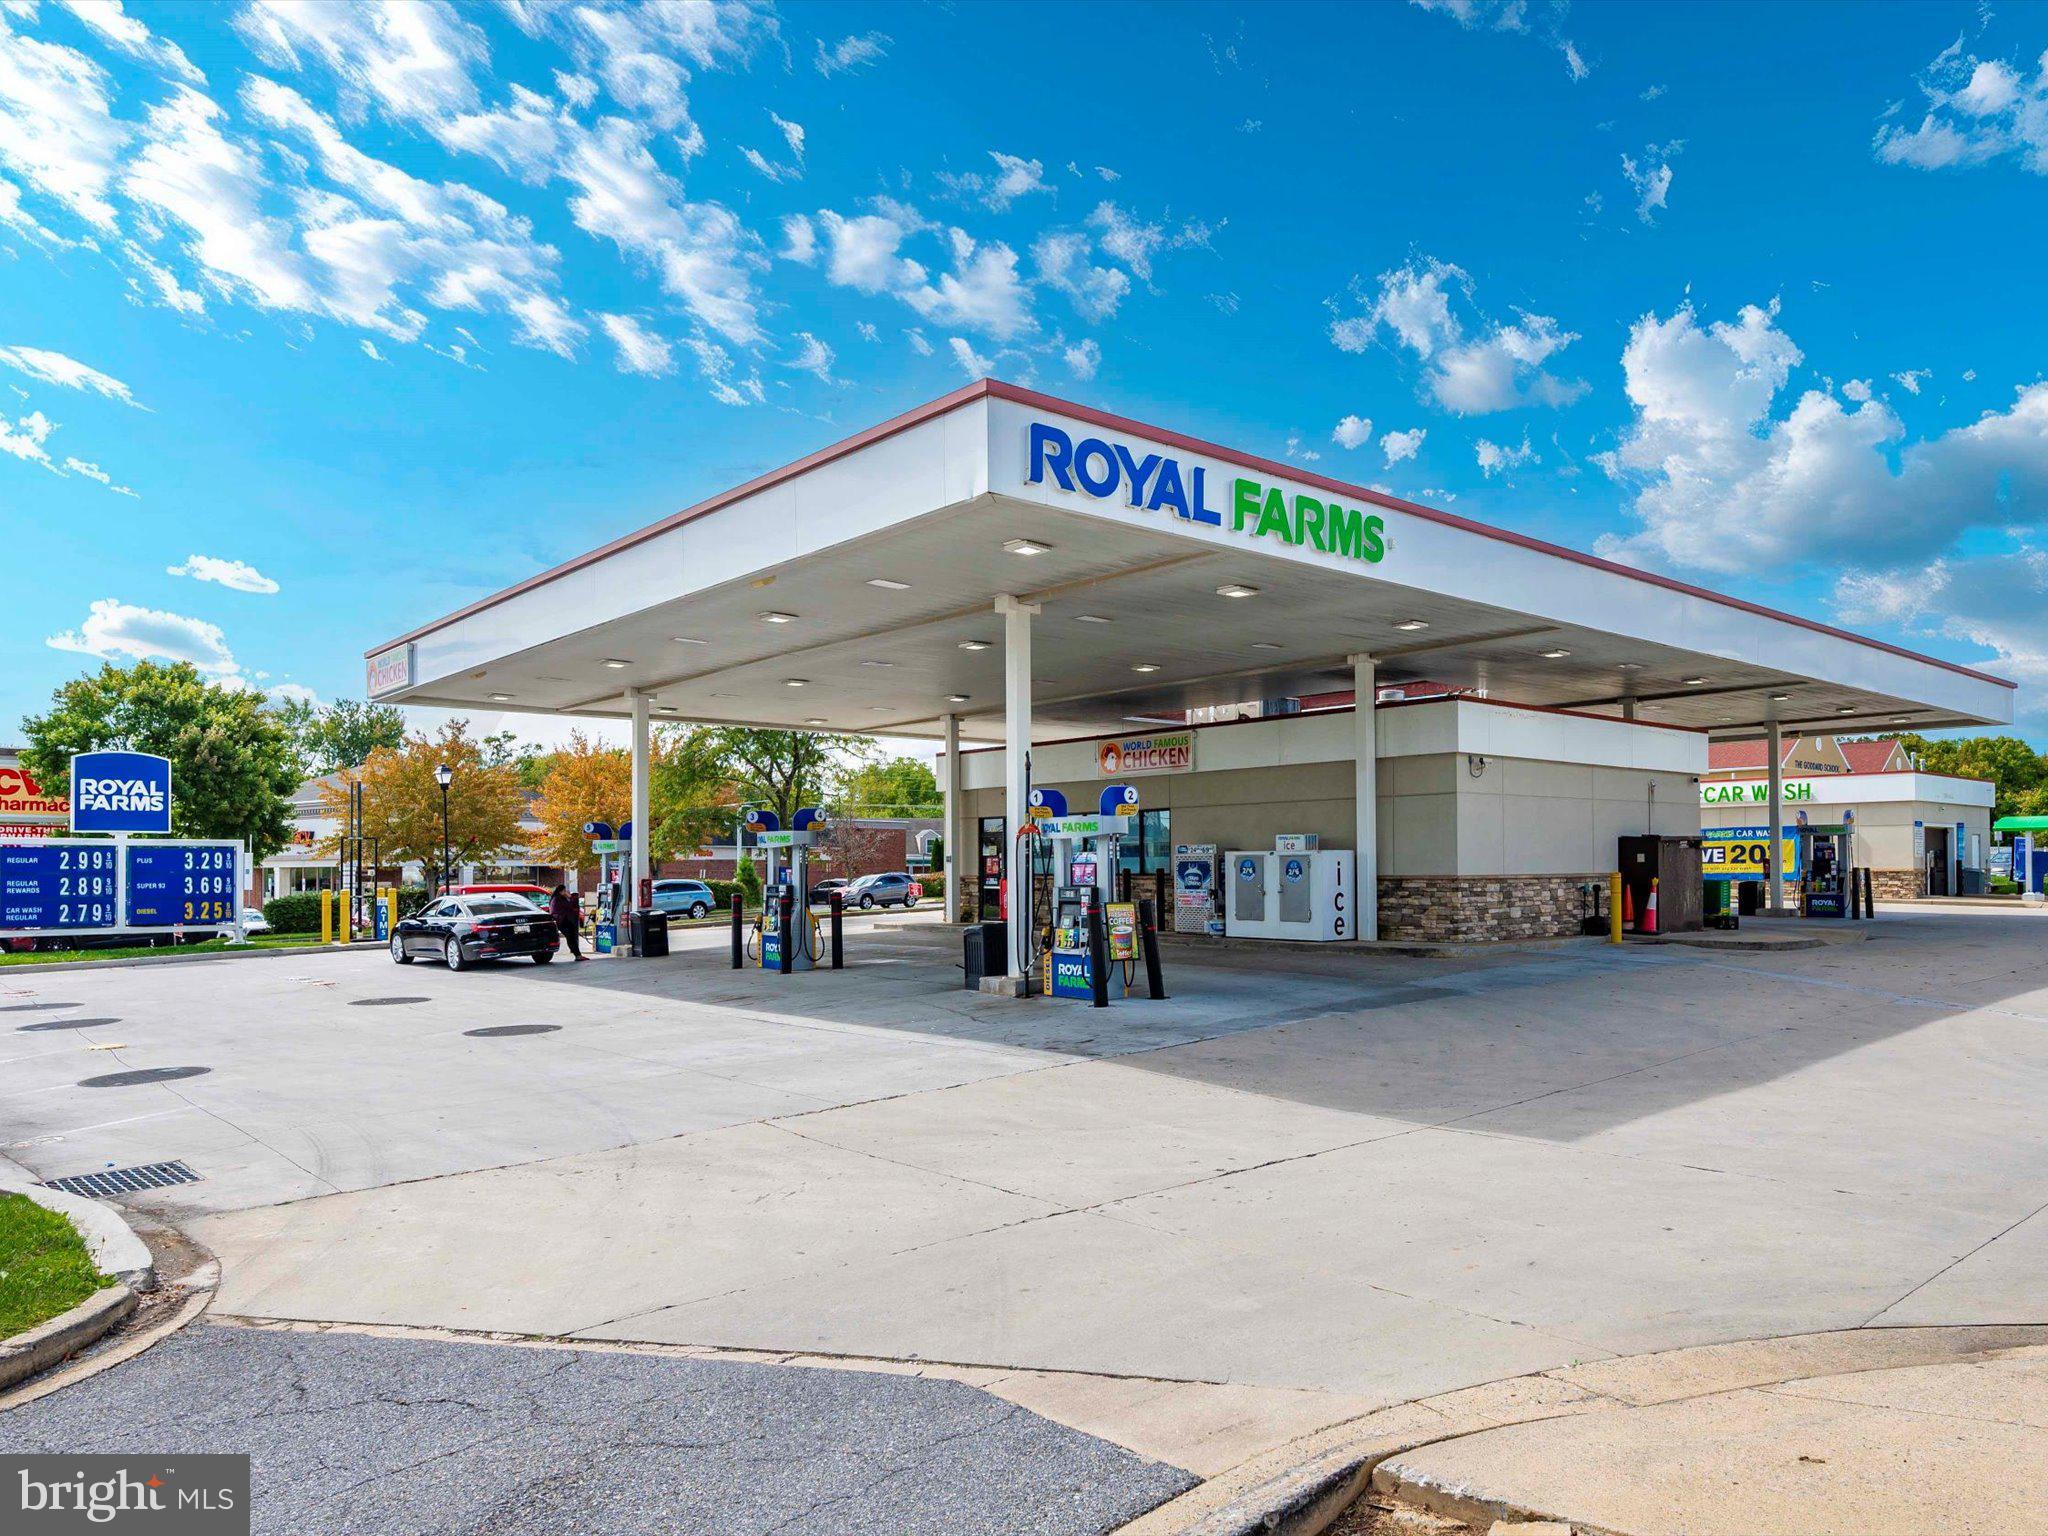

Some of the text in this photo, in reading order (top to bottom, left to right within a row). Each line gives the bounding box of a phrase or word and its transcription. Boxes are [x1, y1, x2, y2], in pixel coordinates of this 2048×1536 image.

[1027, 423, 1385, 563] ROYAL FARMS
[1123, 736, 1188, 751] WORLD FAMOUS
[1123, 746, 1188, 768] CHICKEN
[80, 779, 164, 796] ROYAL
[1703, 783, 1812, 803] CAR WSH
[0, 795, 70, 812] harmac
[80, 795, 164, 811] FARMS
[1062, 821, 1098, 832] FARMS
[1283, 841, 1295, 850] ice
[1701, 844, 1771, 864] VE 20
[60, 851, 103, 870] 2.99
[184, 852, 223, 870] 3.29
[60, 877, 102, 895] 2.89
[184, 877, 222, 894] 3.69
[1334, 860, 1345, 936] ice
[60, 904, 102, 922] 2.79
[184, 902, 223, 919] 3.25
[1109, 917, 1134, 925] COFFEE
[1058, 963, 1090, 976] ROYAL
